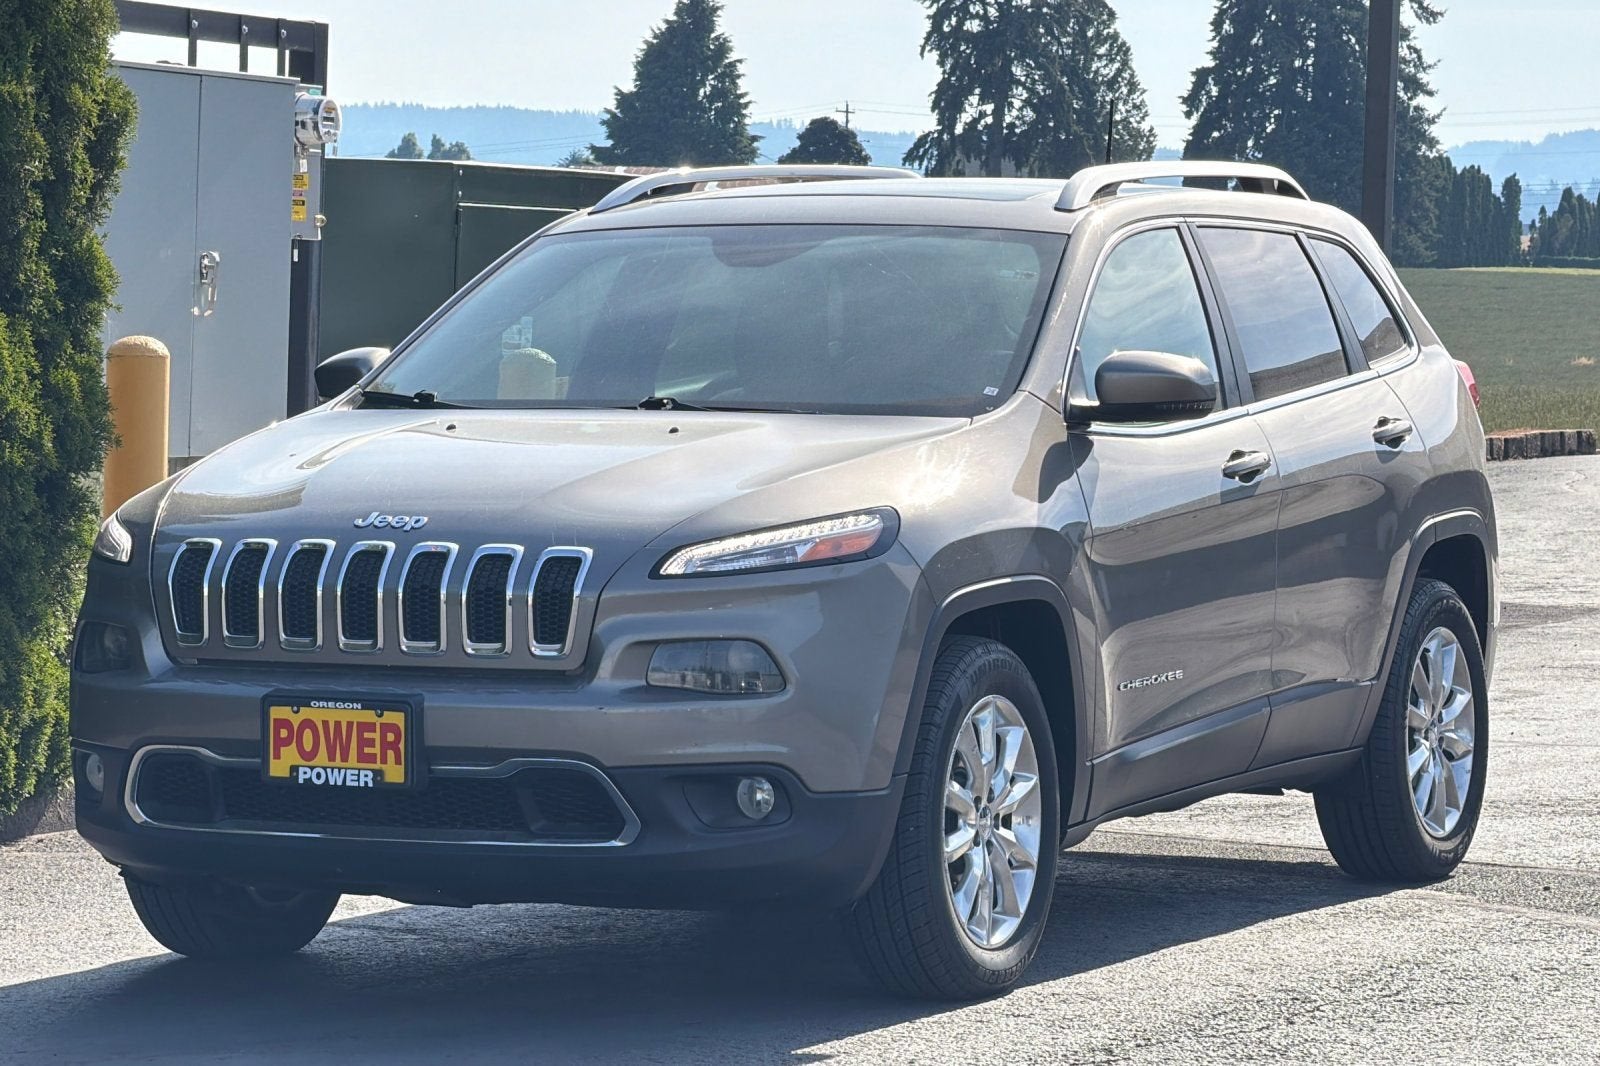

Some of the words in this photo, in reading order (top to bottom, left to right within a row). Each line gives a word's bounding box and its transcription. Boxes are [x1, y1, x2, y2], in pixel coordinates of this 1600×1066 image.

[353, 511, 429, 532] Jeep
[1118, 669, 1184, 691] CHEROKEE
[310, 700, 362, 710] OREGON
[272, 717, 403, 765] POWER
[298, 766, 374, 787] POWER
